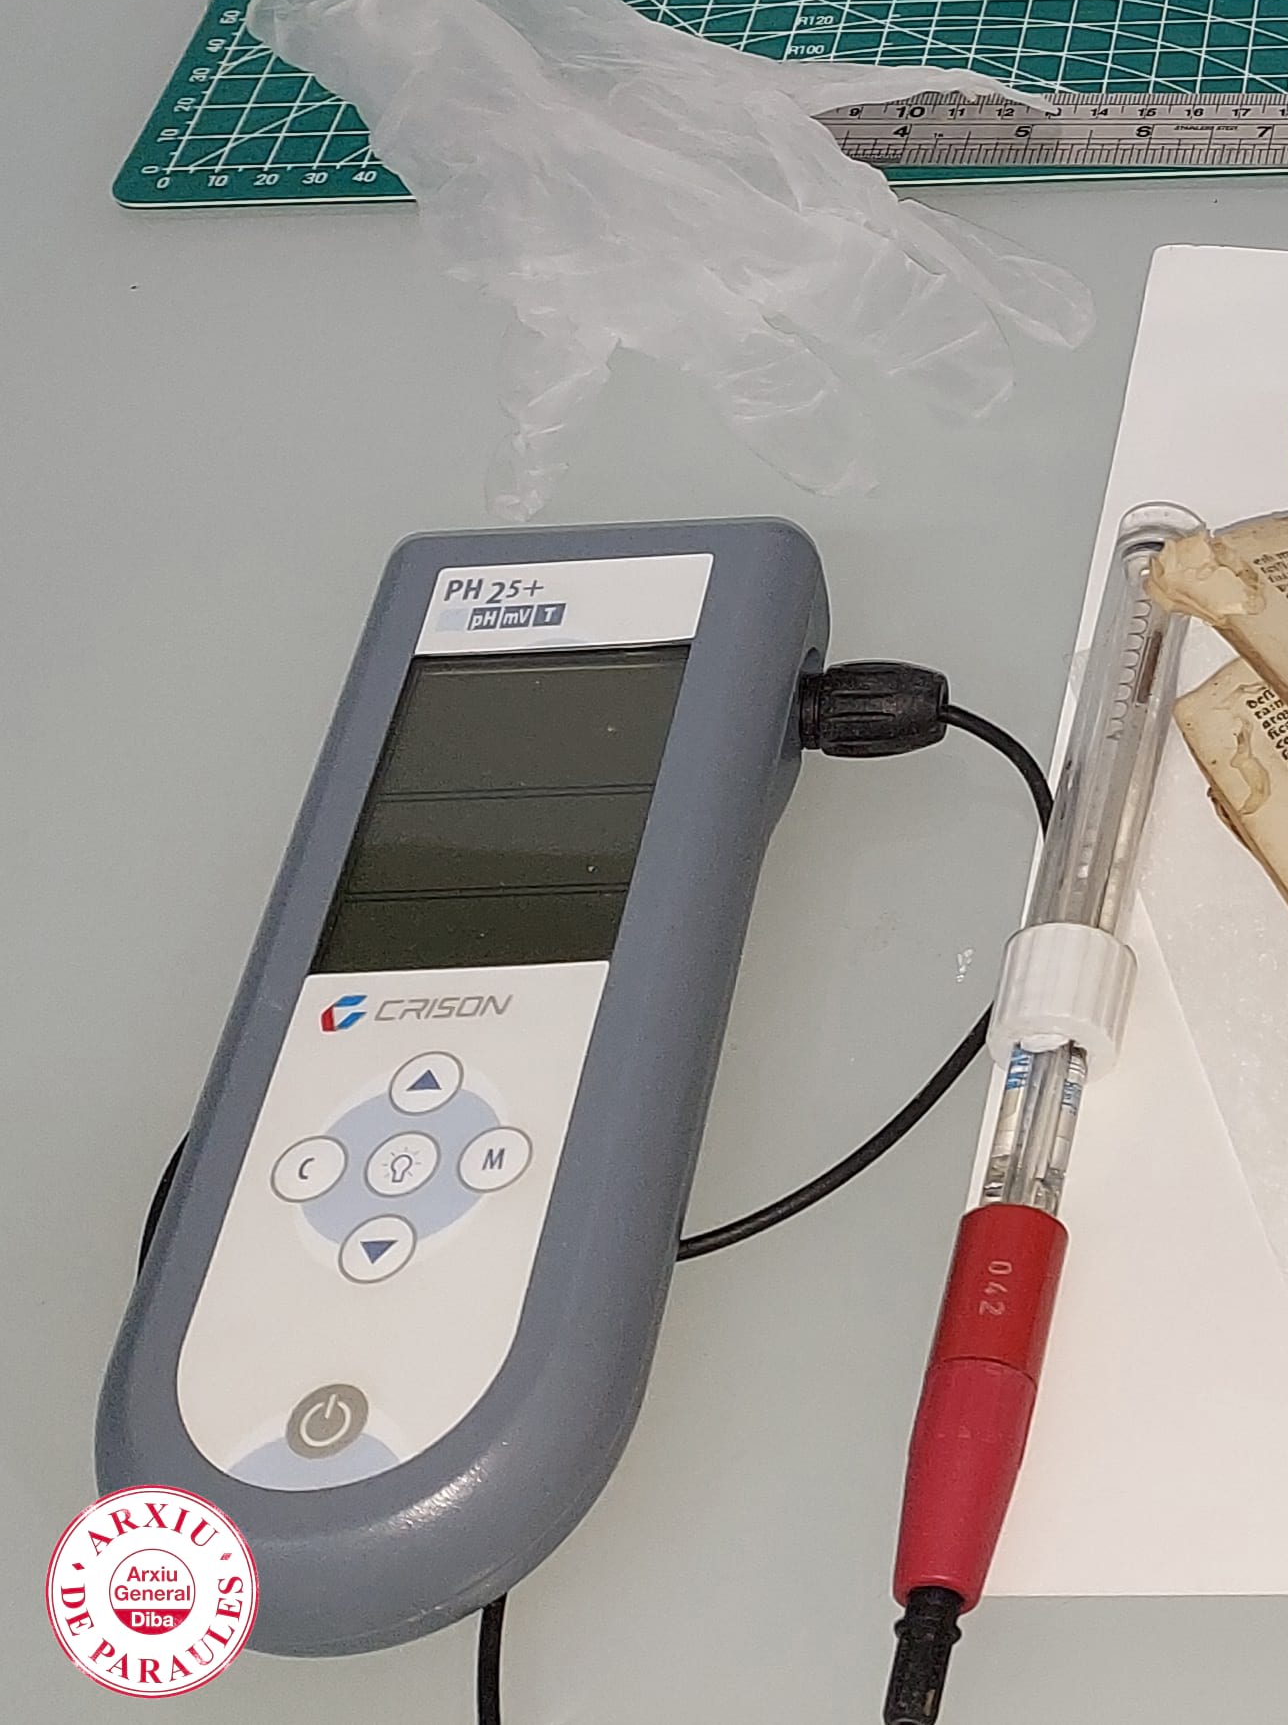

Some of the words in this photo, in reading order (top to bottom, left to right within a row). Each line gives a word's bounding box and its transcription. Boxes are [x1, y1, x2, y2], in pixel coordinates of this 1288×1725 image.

[206, 38, 226, 53] 40
[189, 67, 211, 83] 30
[173, 97, 194, 113] 20
[895, 104, 926, 120] 10
[947, 106, 967, 119] 11
[995, 106, 1016, 119] 12
[1088, 106, 1110, 119] 14
[1137, 106, 1158, 119] 15
[1184, 105, 1205, 119] 16
[1231, 105, 1253, 119] 17
[156, 128, 179, 144] 10
[892, 124, 911, 140] 4
[1013, 124, 1031, 139] 5
[1135, 124, 1153, 138] 6
[1255, 124, 1273, 138] 7
[155, 176, 171, 190] 0
[207, 174, 229, 188] 10
[253, 173, 280, 187] 20
[302, 172, 329, 185] 30
[352, 170, 378, 183] 40
[443, 578, 483, 603] PH
[485, 578, 545, 605] 25+
[471, 609, 498, 631] pH
[502, 607, 531, 626] mV
[373, 994, 514, 1022] CRISON
[299, 1156, 316, 1181] C
[482, 1147, 506, 1172] M
